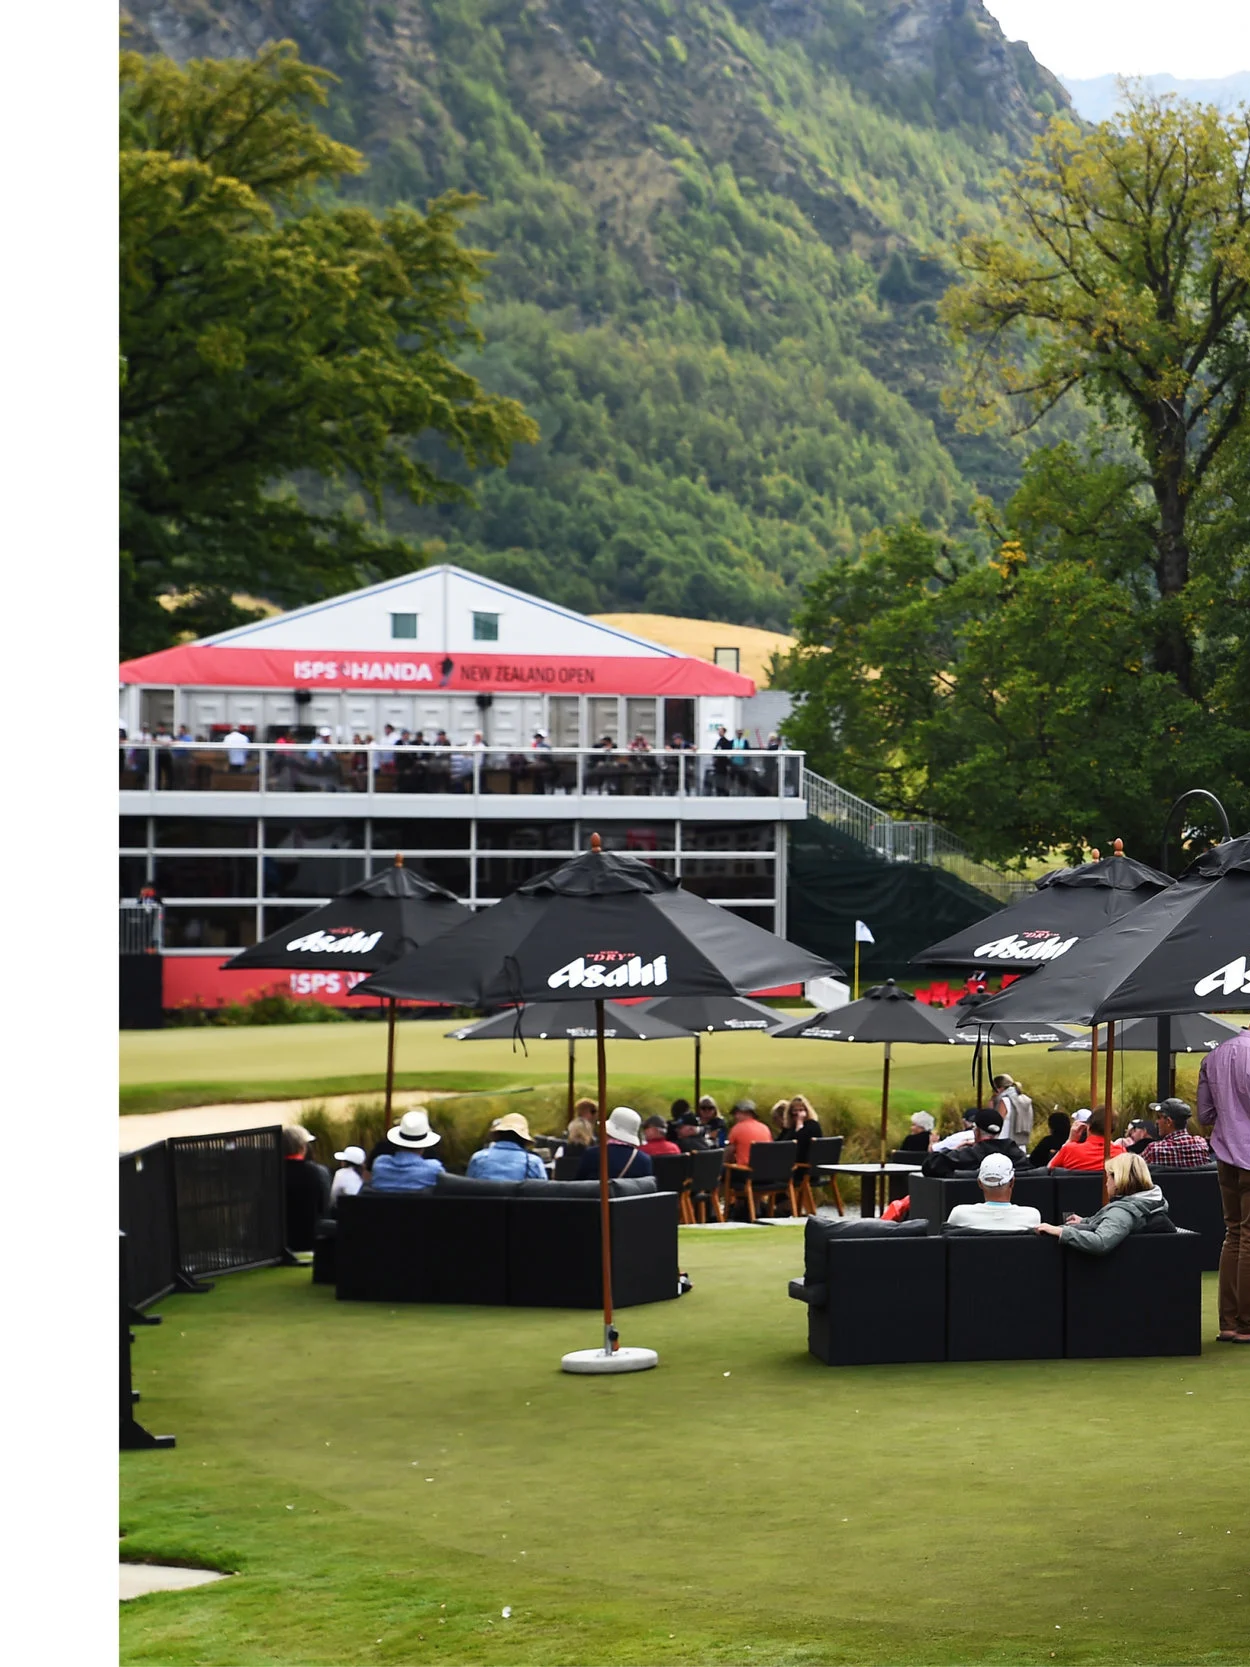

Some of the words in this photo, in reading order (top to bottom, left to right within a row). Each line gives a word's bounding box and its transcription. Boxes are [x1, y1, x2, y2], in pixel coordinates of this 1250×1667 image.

[293, 660, 337, 680] ISPS
[351, 662, 433, 682] HANDA
[460, 665, 492, 682] NEW
[494, 665, 555, 683] ZEALAND
[557, 667, 596, 684] OPEN
[286, 930, 384, 954] Asahi
[974, 934, 1080, 960] Asahi
[289, 973, 341, 994] ISPS
[547, 955, 668, 988] Asahi
